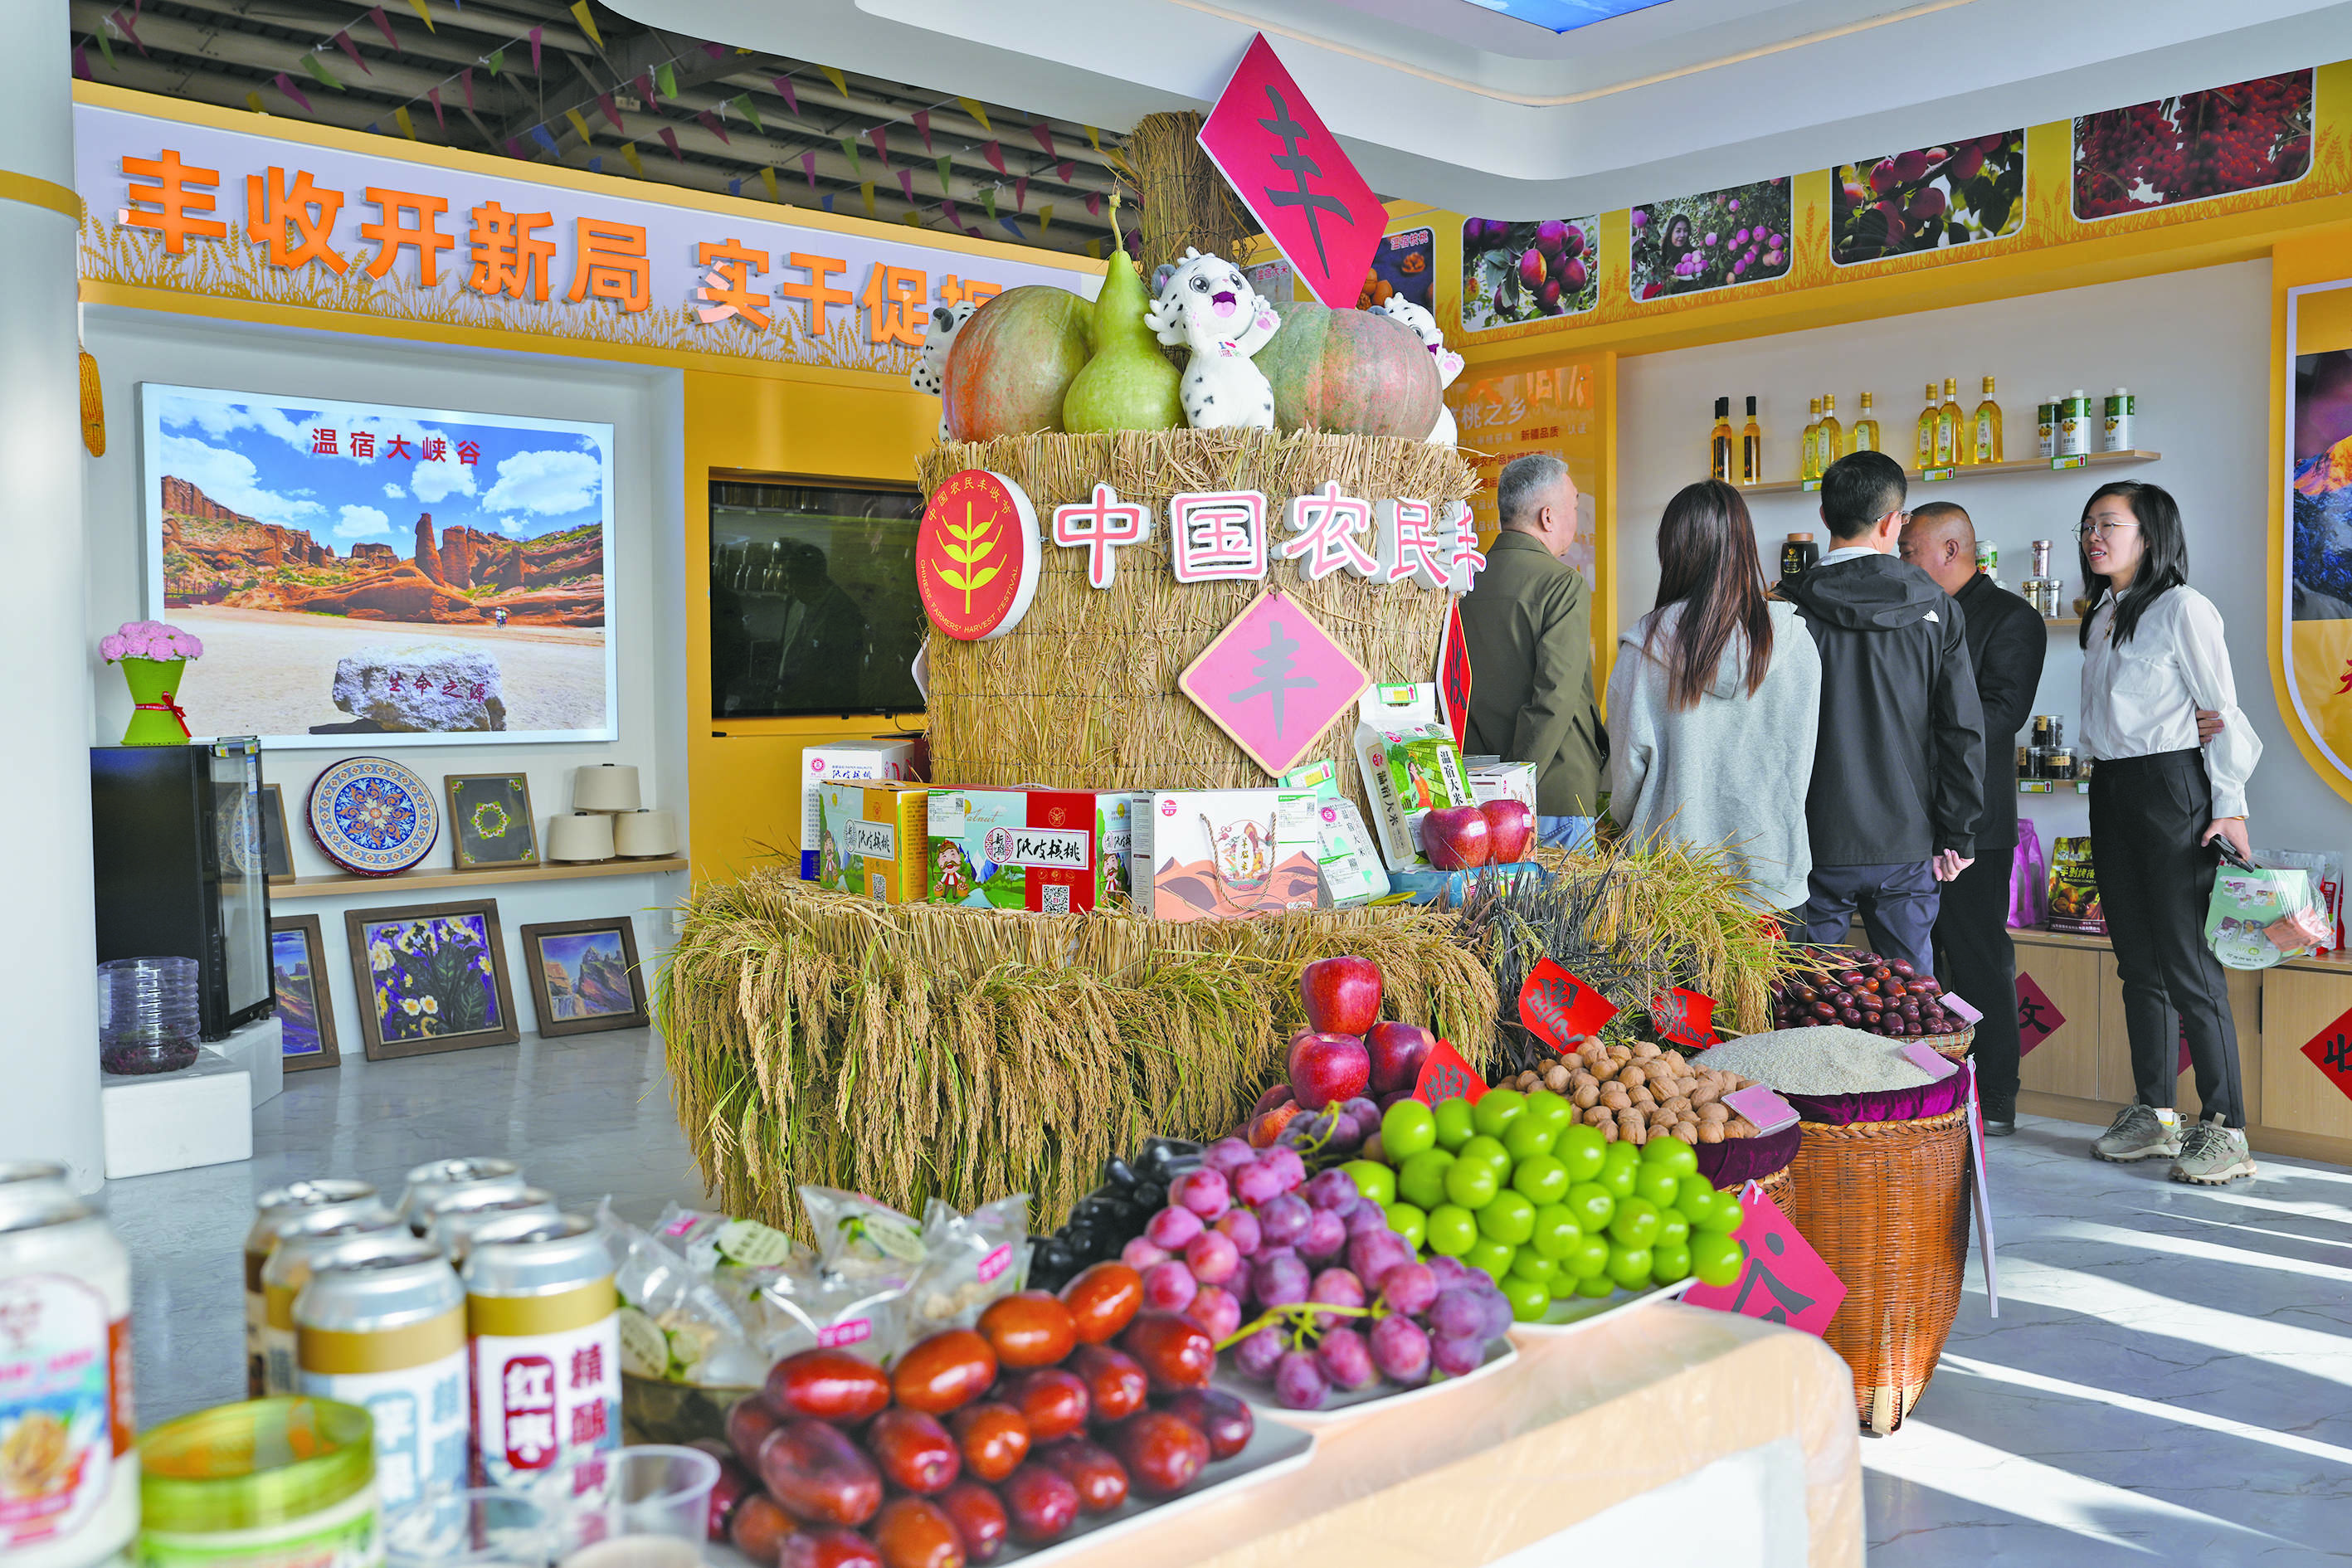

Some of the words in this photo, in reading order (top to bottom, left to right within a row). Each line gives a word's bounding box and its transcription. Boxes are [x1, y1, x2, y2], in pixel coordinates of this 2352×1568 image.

[117, 149, 650, 314] 丰收开新局
[312, 427, 480, 465] 温宿大峡谷
[1521, 426, 1560, 441] 新疆品质
[918, 558, 932, 601] CHINESE
[963, 612, 996, 634] HARVEST
[996, 565, 1020, 613] FESTIVAL
[388, 672, 486, 704] 生命之源
[1228, 620, 1319, 742] 丰
[1376, 770, 1400, 826] 温宿大米
[1440, 750, 1463, 806] 温宿大米
[965, 806, 1004, 824] alnut
[858, 830, 891, 853] 纸皮核桃
[1016, 837, 1081, 862] 纸皮核桃
[506, 1363, 557, 1465] 红枣
